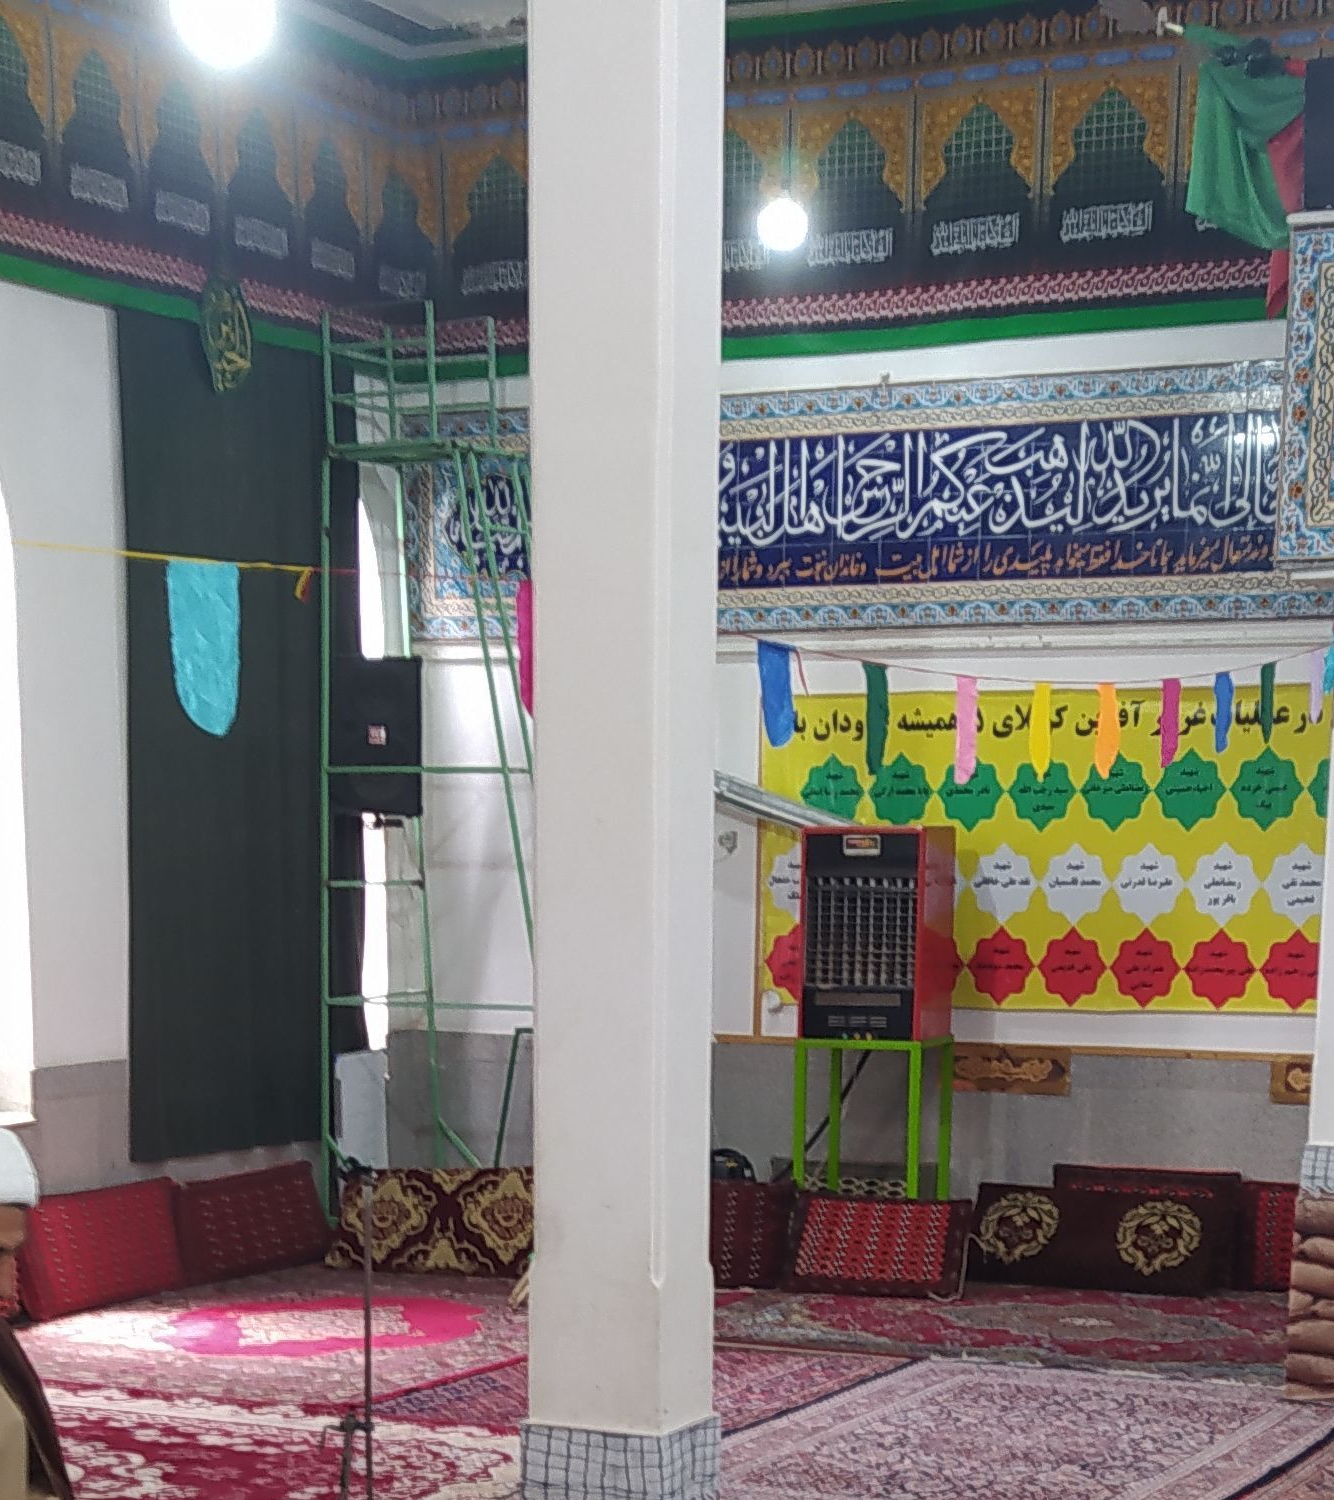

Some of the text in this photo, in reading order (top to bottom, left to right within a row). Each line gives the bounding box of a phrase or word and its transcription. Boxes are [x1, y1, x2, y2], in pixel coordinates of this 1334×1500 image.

[992, 860, 1013, 871] شهید
[1066, 859, 1086, 871] شهید
[1139, 859, 1160, 871] شهید
[1213, 859, 1234, 871] شهید
[1291, 859, 1313, 871] شهید
